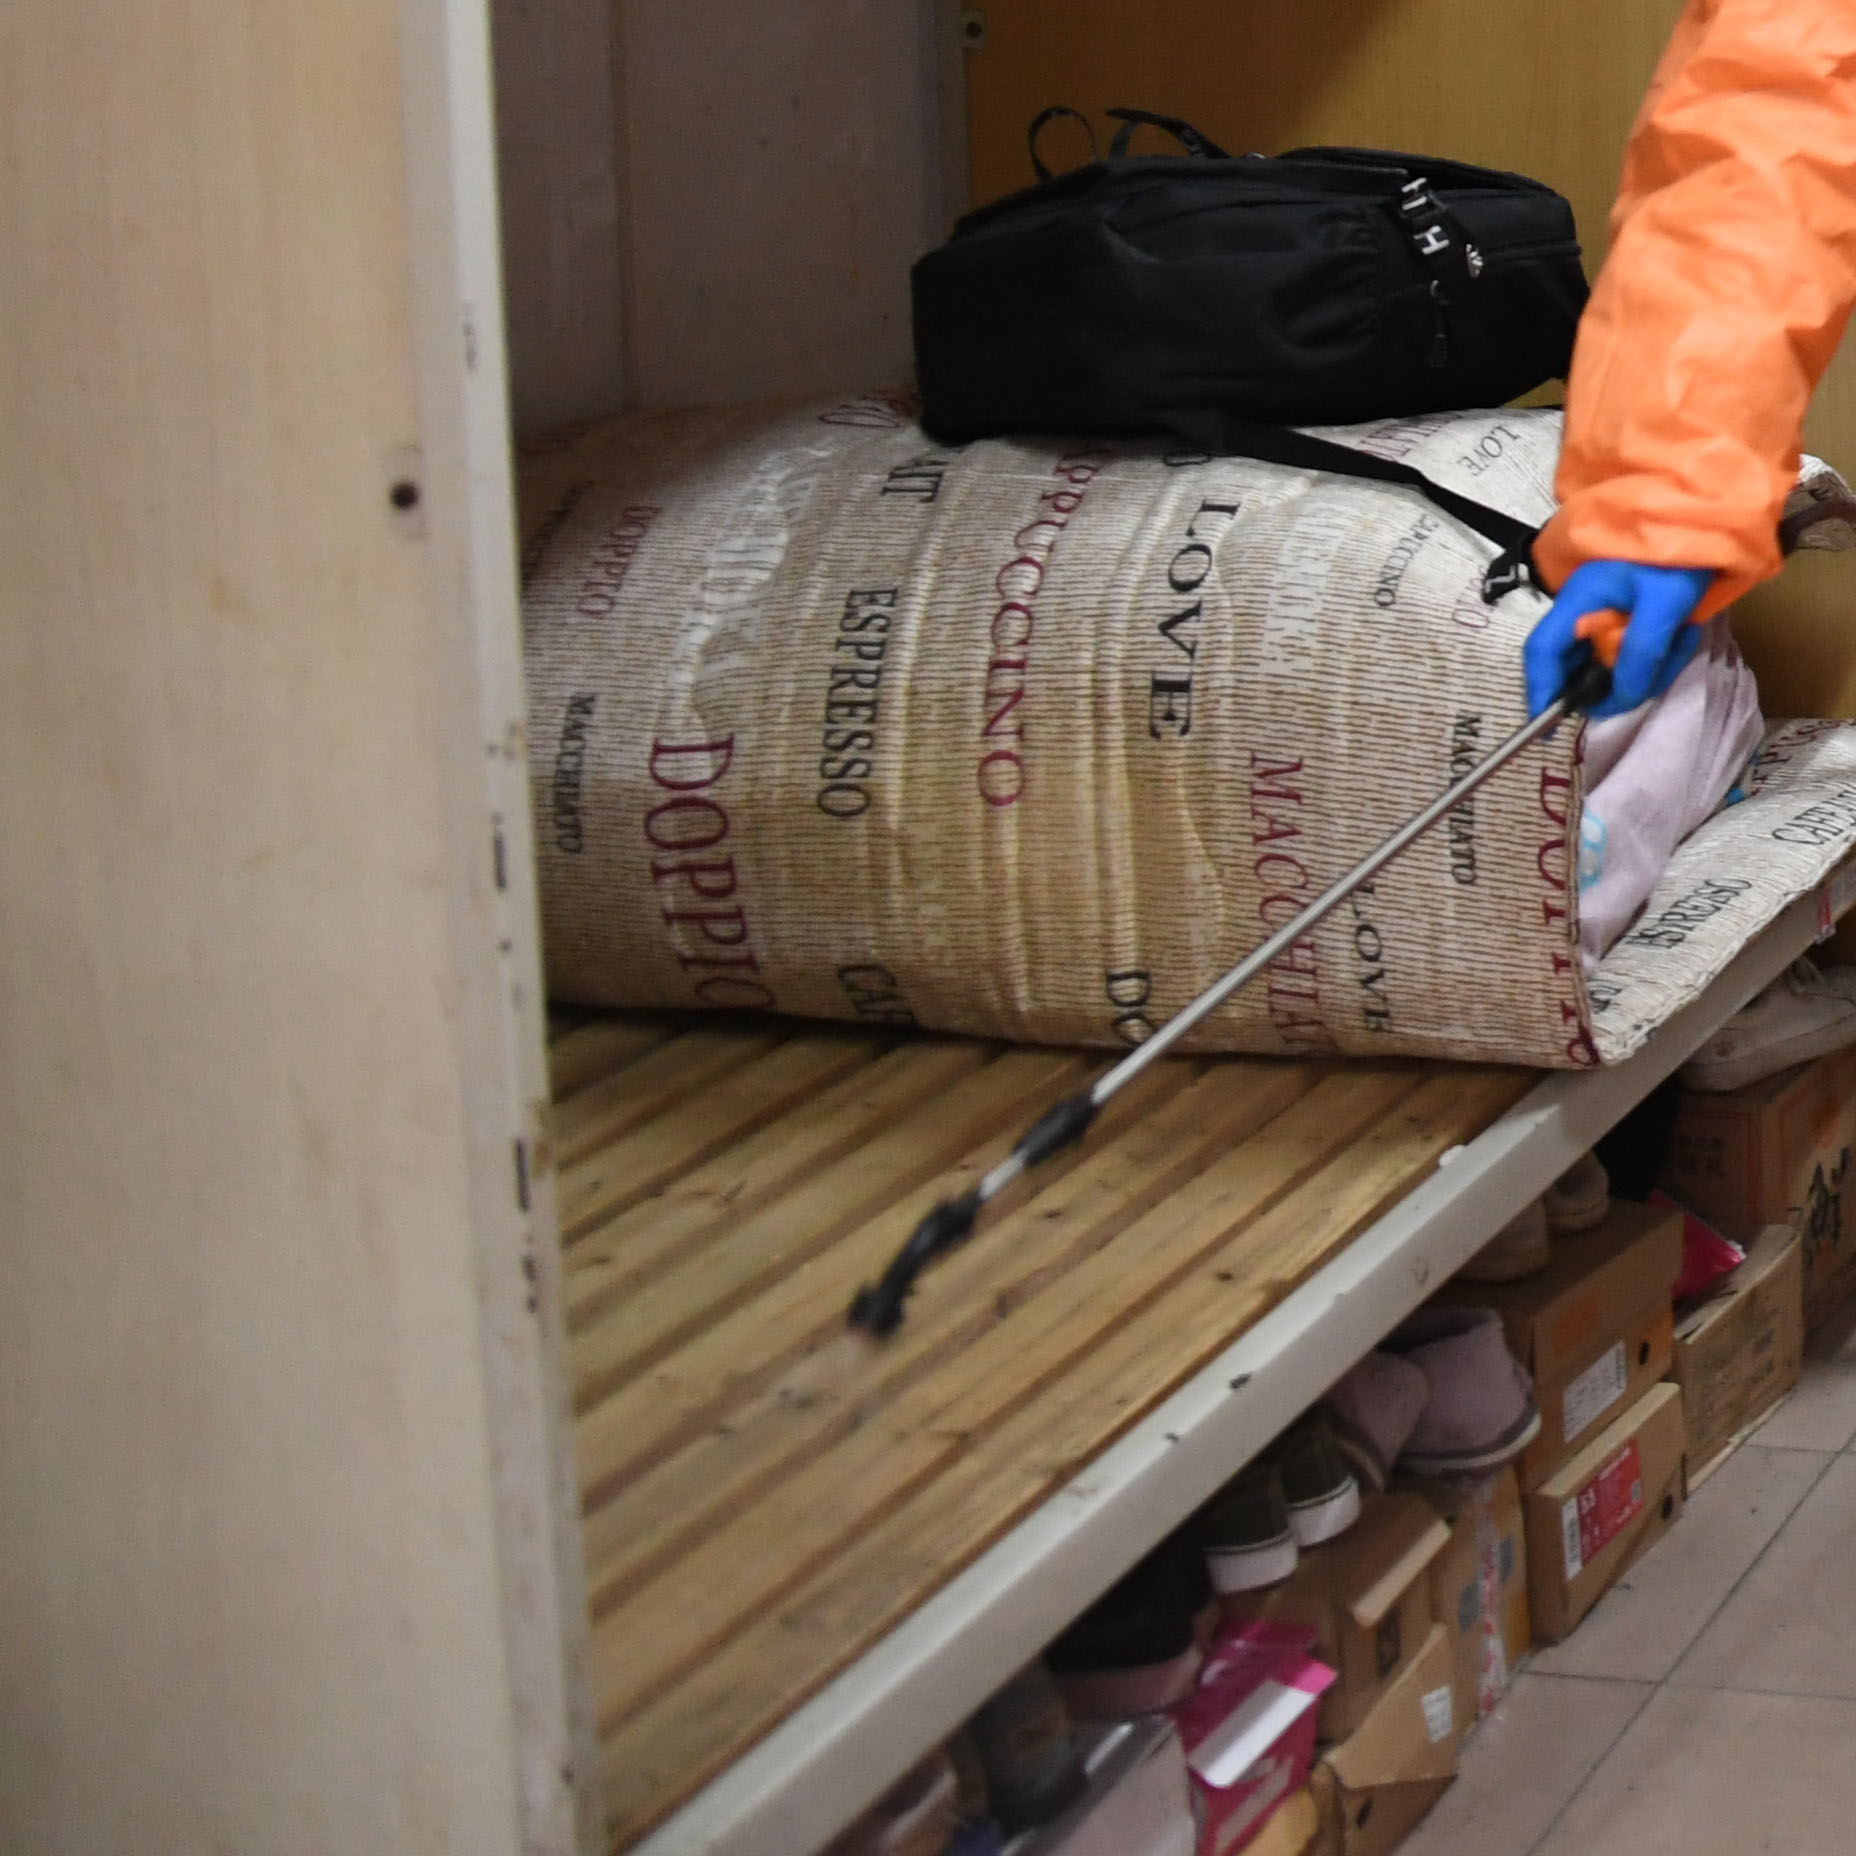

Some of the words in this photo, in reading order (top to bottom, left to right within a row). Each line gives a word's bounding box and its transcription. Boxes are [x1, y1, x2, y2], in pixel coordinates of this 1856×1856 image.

[1457, 425, 1520, 477] LOVE
[817, 587, 898, 818] ESPRESSO
[1150, 499, 1241, 741] LOVE
[644, 731, 776, 1010] DOPPIO
[1351, 880, 1394, 1035] LOVE
